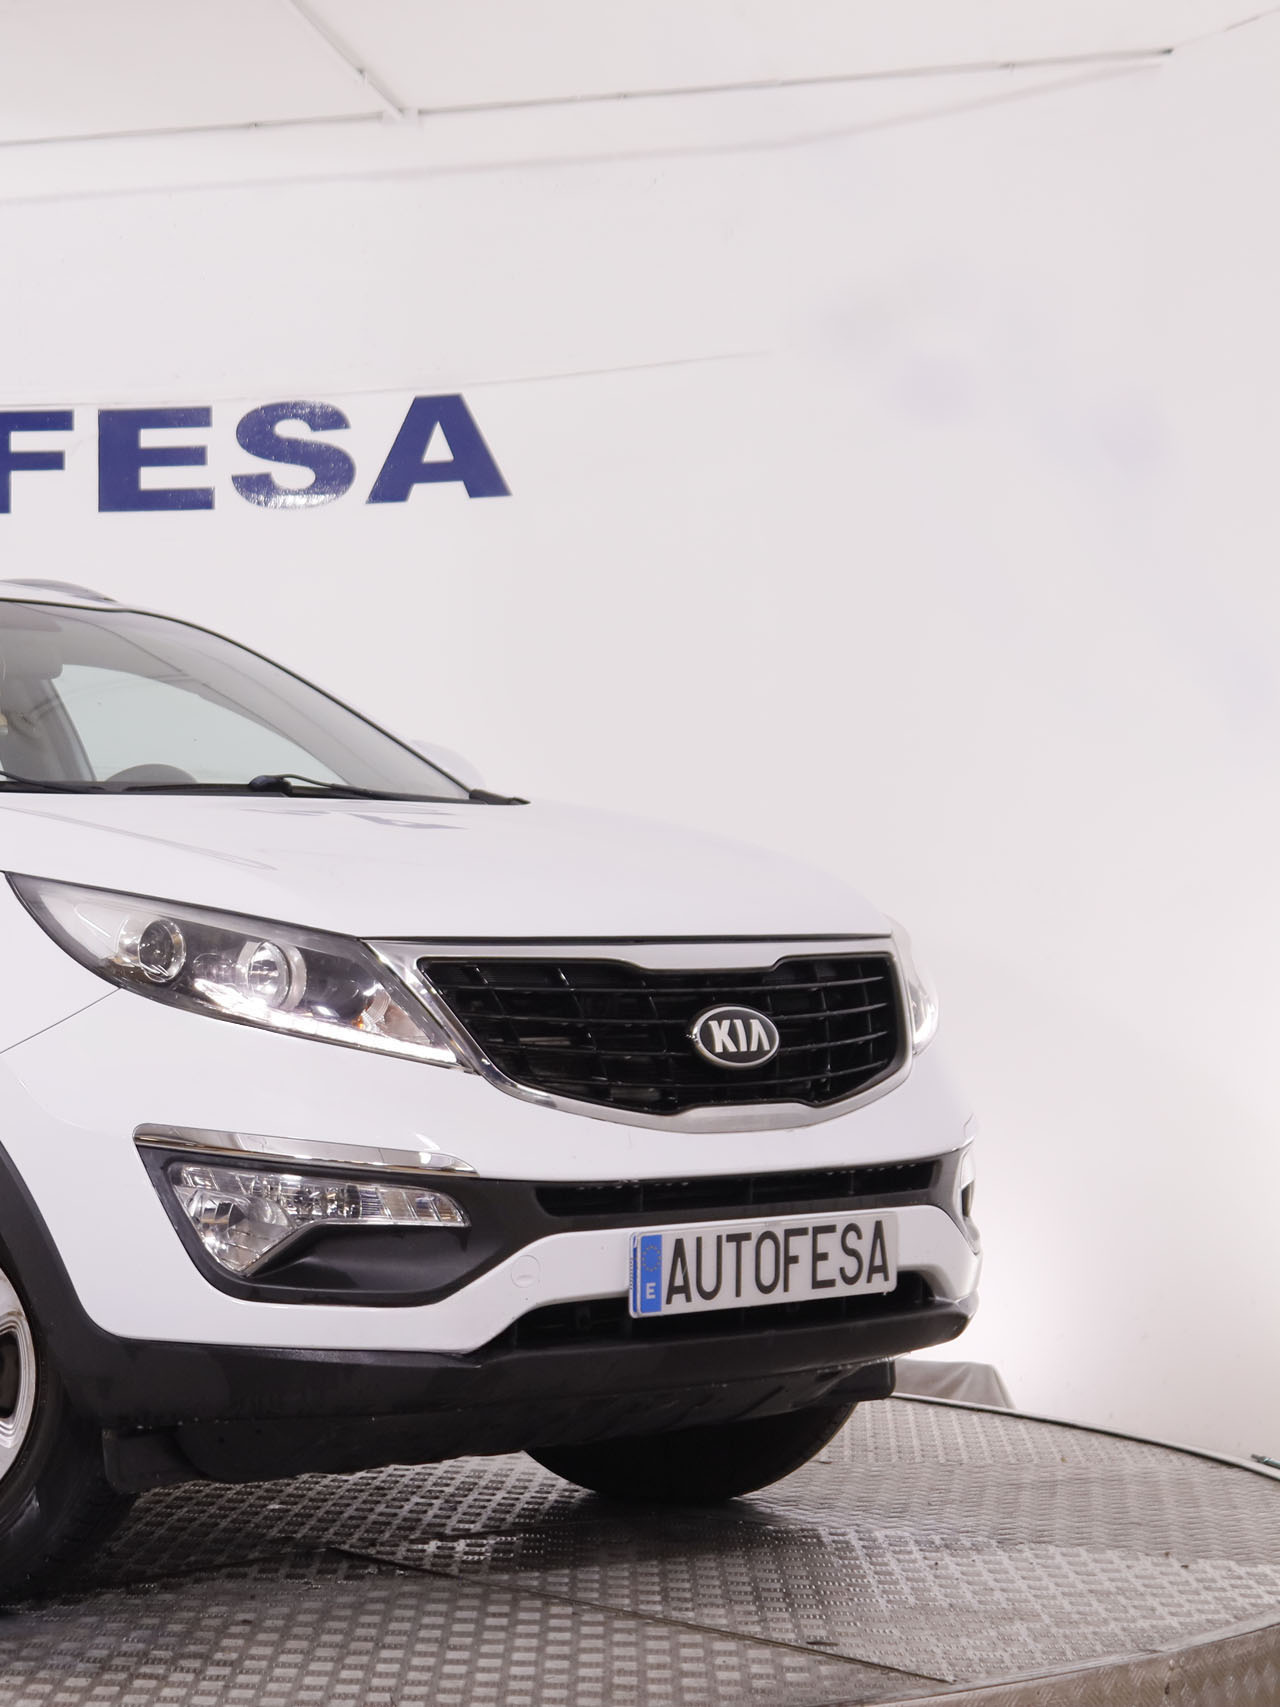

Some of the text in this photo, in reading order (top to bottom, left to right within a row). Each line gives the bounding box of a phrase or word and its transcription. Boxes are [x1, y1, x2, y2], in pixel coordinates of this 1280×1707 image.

[708, 1019, 771, 1052] KIA
[666, 1220, 889, 1305] AUTOFESA
[646, 1282, 656, 1299] E
